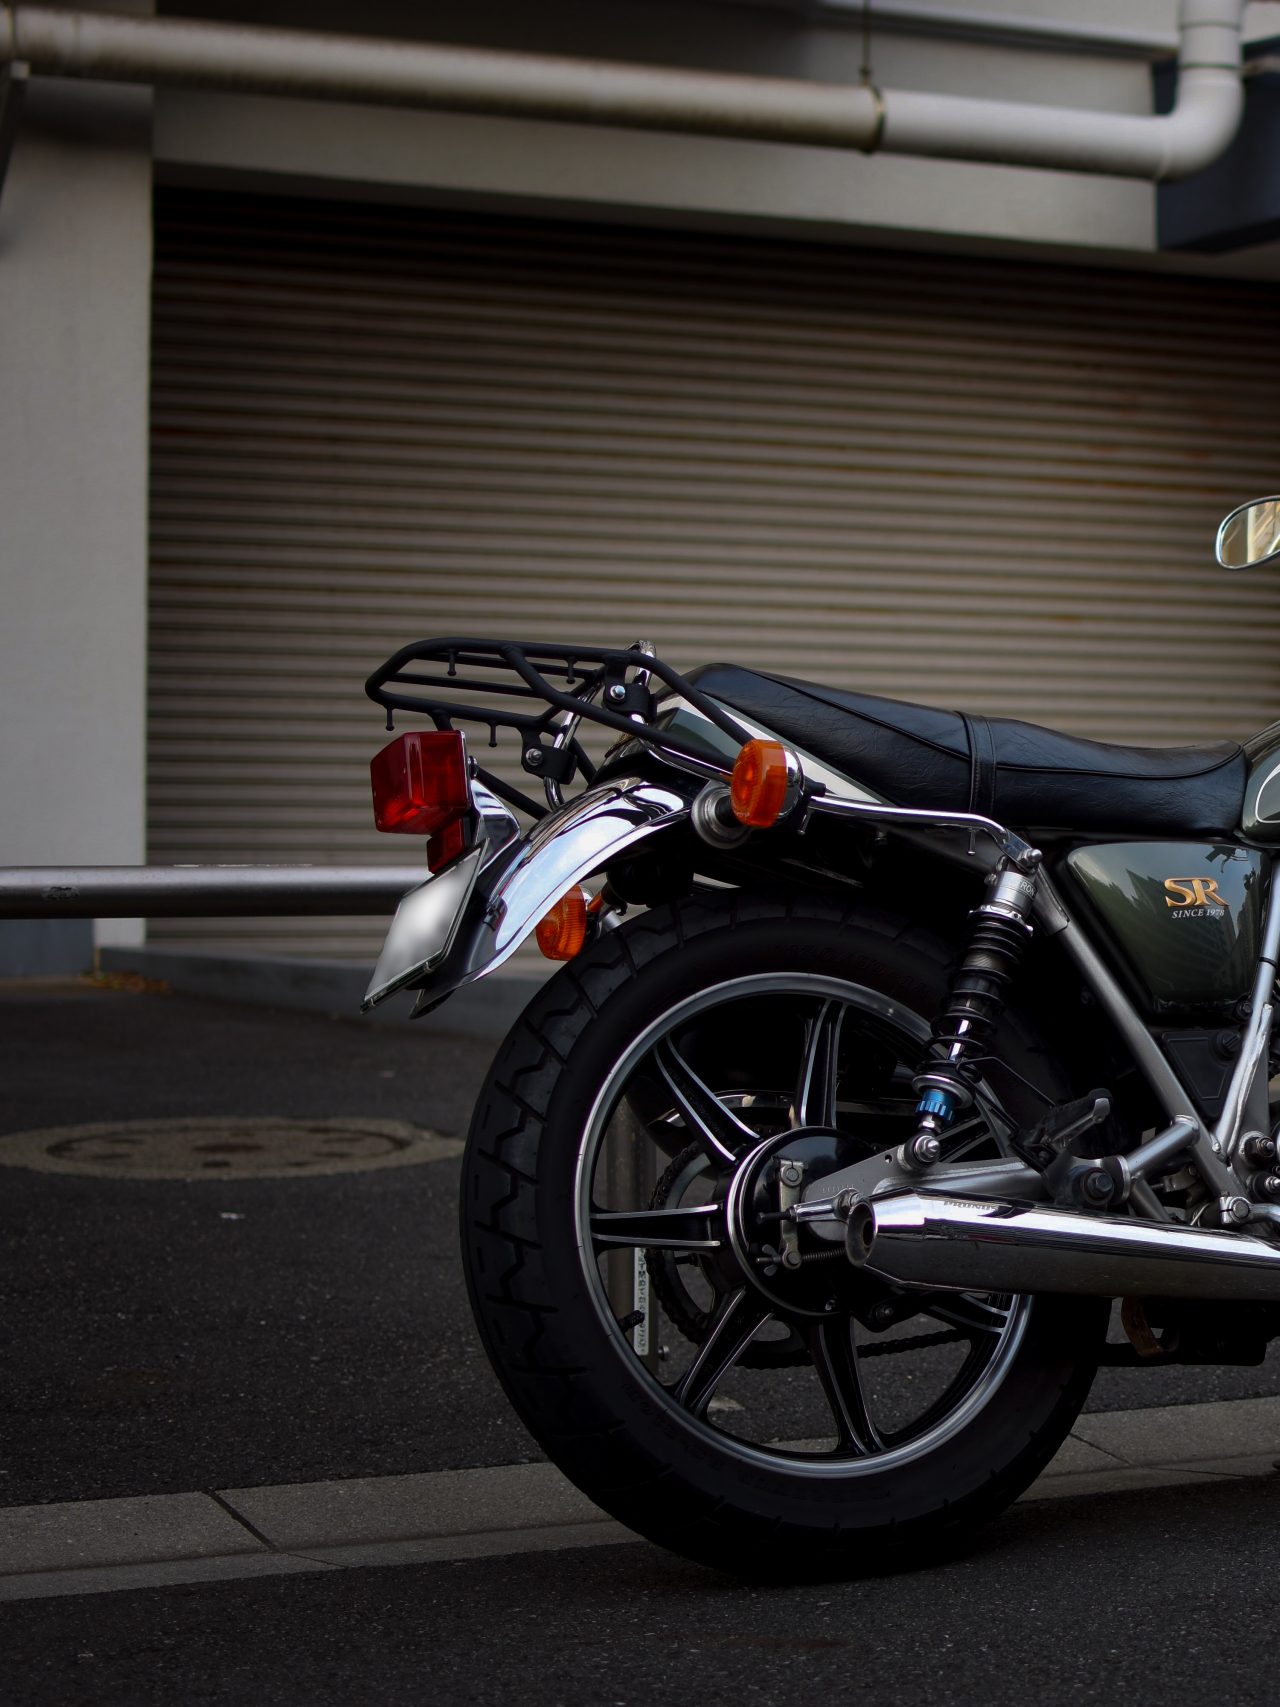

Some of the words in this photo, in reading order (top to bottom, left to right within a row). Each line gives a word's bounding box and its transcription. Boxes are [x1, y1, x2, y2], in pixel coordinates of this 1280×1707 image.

[1164, 877, 1231, 907] SR
[1171, 909, 1204, 919] SINCE
[1206, 908, 1225, 917] 1978
